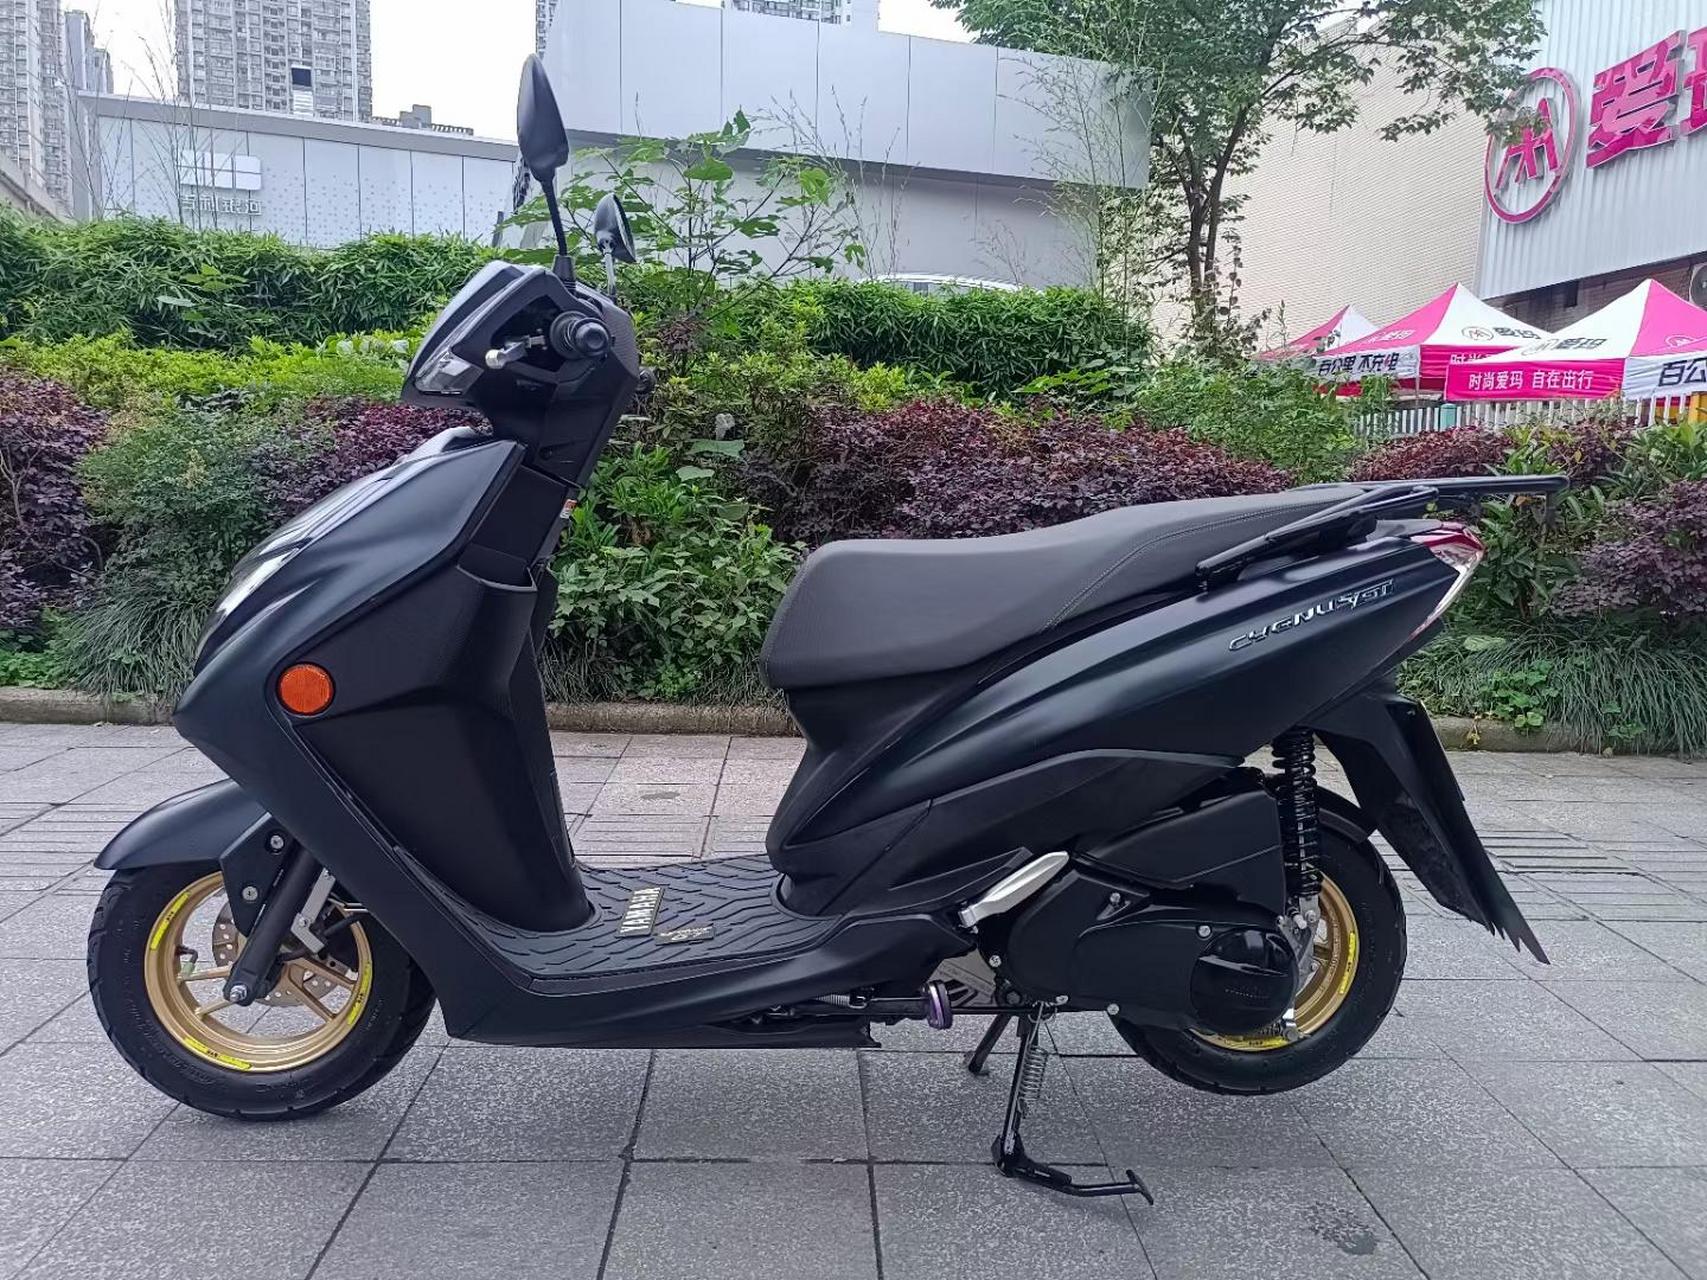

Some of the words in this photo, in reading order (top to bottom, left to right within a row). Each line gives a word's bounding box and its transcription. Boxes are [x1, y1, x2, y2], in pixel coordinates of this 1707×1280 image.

[1586, 26, 1707, 168] 爱
[1468, 370, 1524, 391] 时尚爱玛
[1531, 369, 1594, 390] 自在出行
[619, 887, 661, 933] YAMAHA
